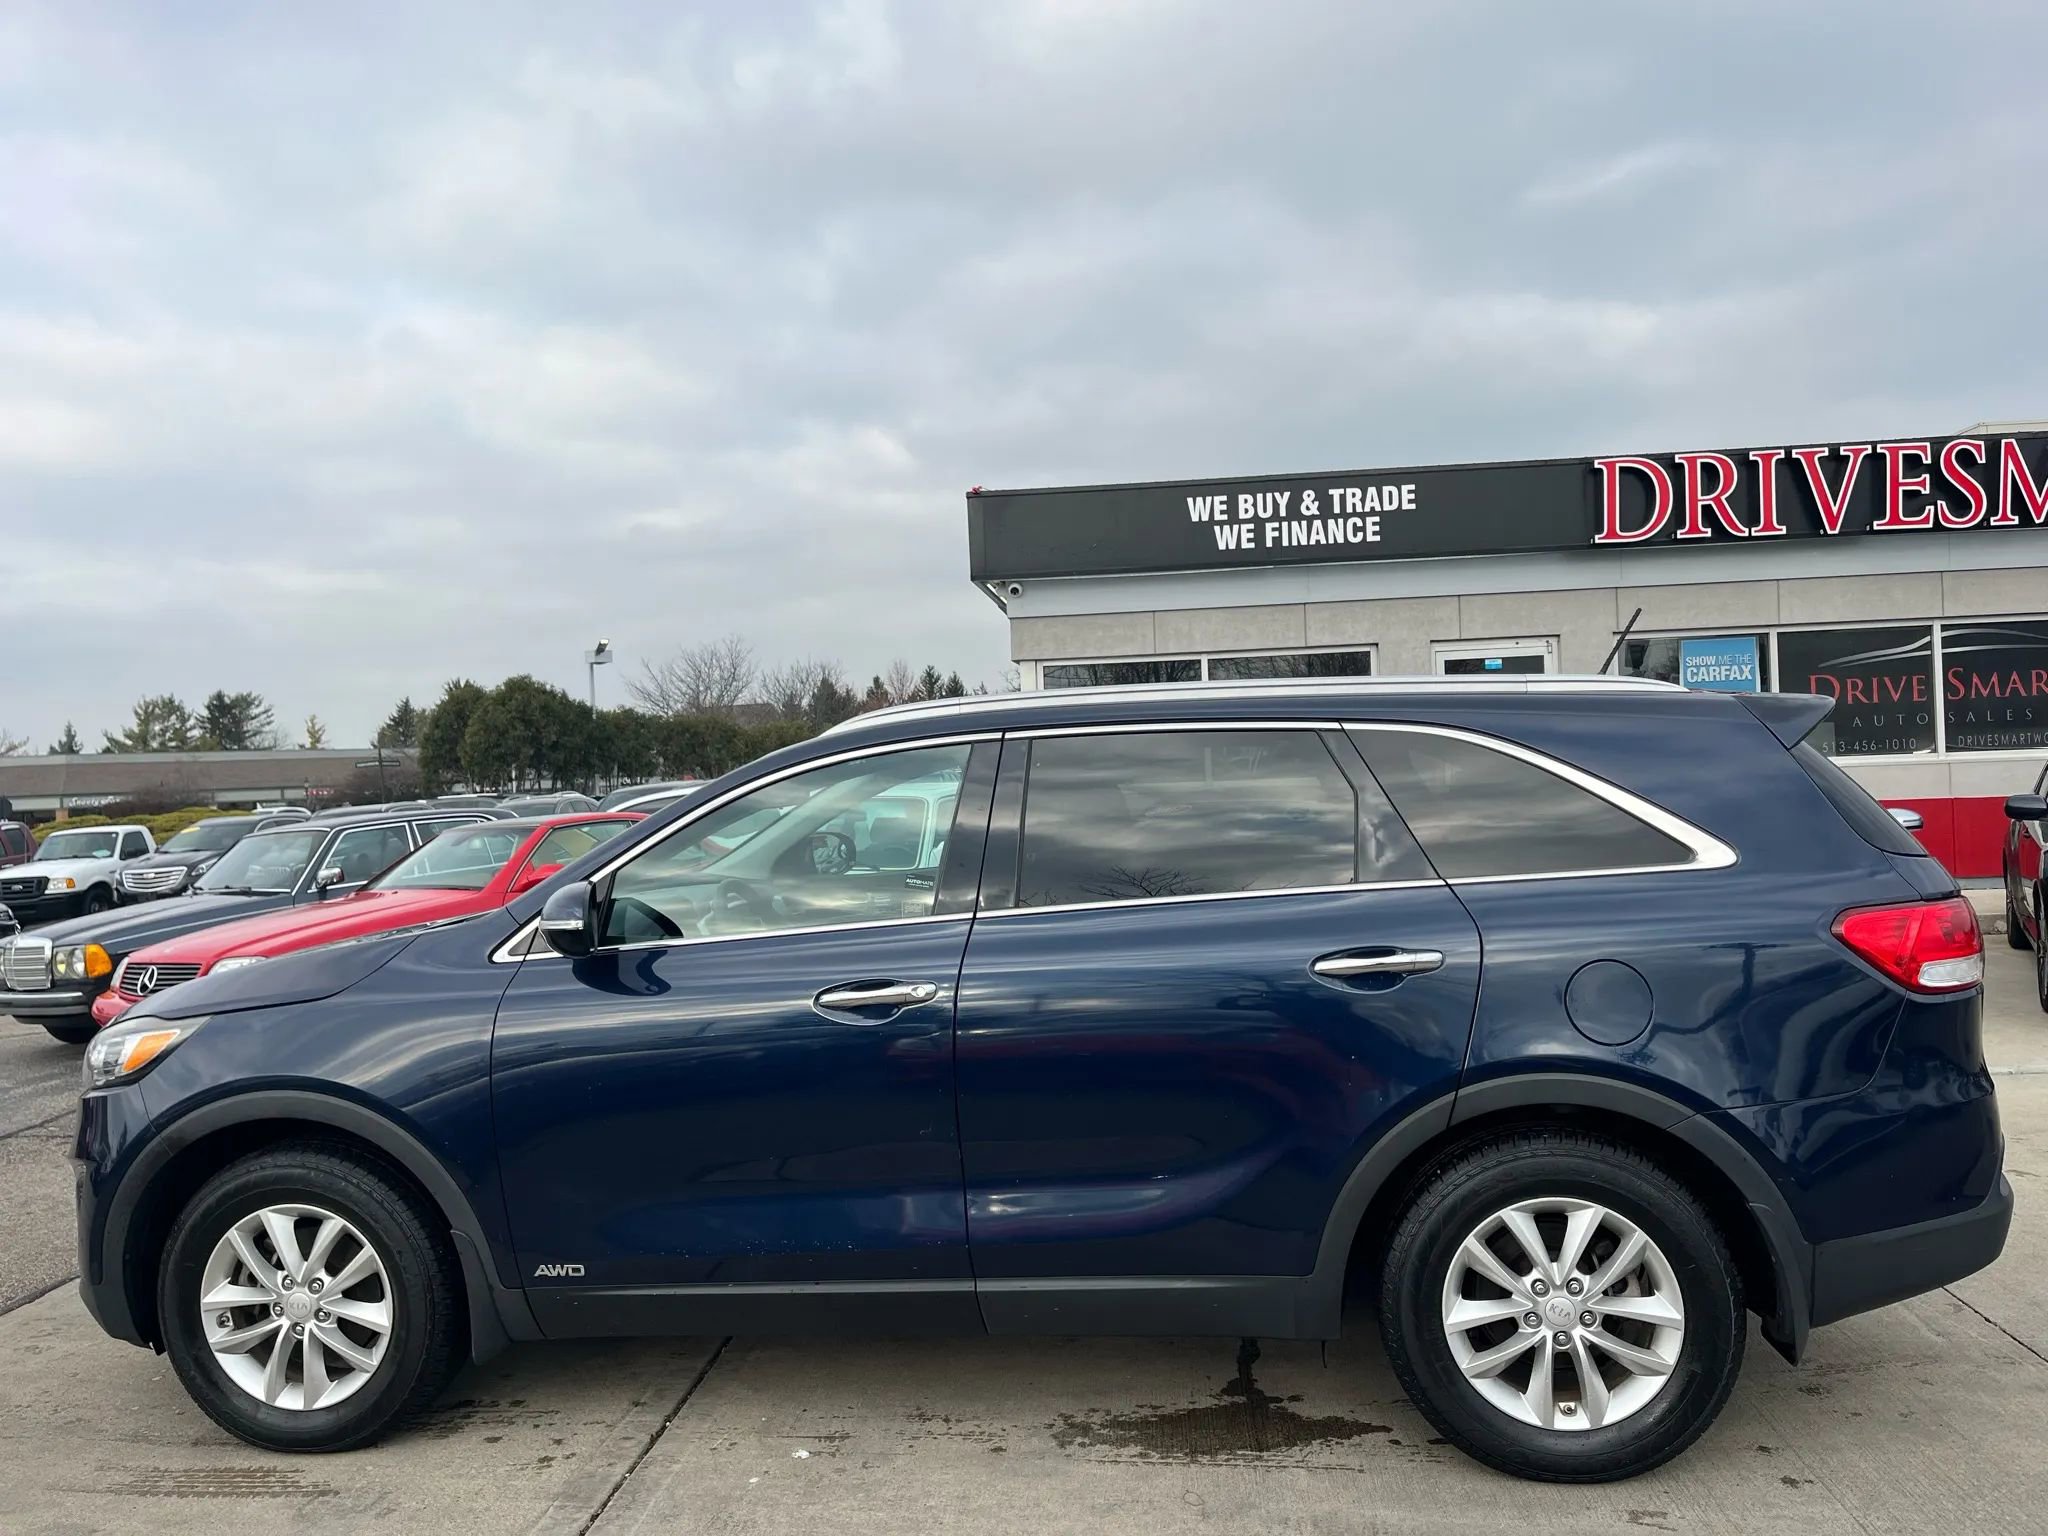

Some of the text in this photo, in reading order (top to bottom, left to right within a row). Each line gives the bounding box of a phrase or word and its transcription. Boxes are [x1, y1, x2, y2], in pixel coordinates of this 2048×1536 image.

[1594, 438, 2048, 545] DRIVESM
[1186, 484, 1417, 522] WE BUY & TRADE
[1213, 516, 1381, 550] WE FINANCE
[1685, 653, 1753, 667] SHOW ME THE
[1686, 664, 1753, 683] CARFAX
[1947, 667, 2048, 700] SMAR
[1853, 708, 2032, 727] AUTO SALES
[1822, 738, 1917, 753] 513-456-1010
[534, 1264, 585, 1277] AWD
[1549, 1303, 1571, 1320] KIA
